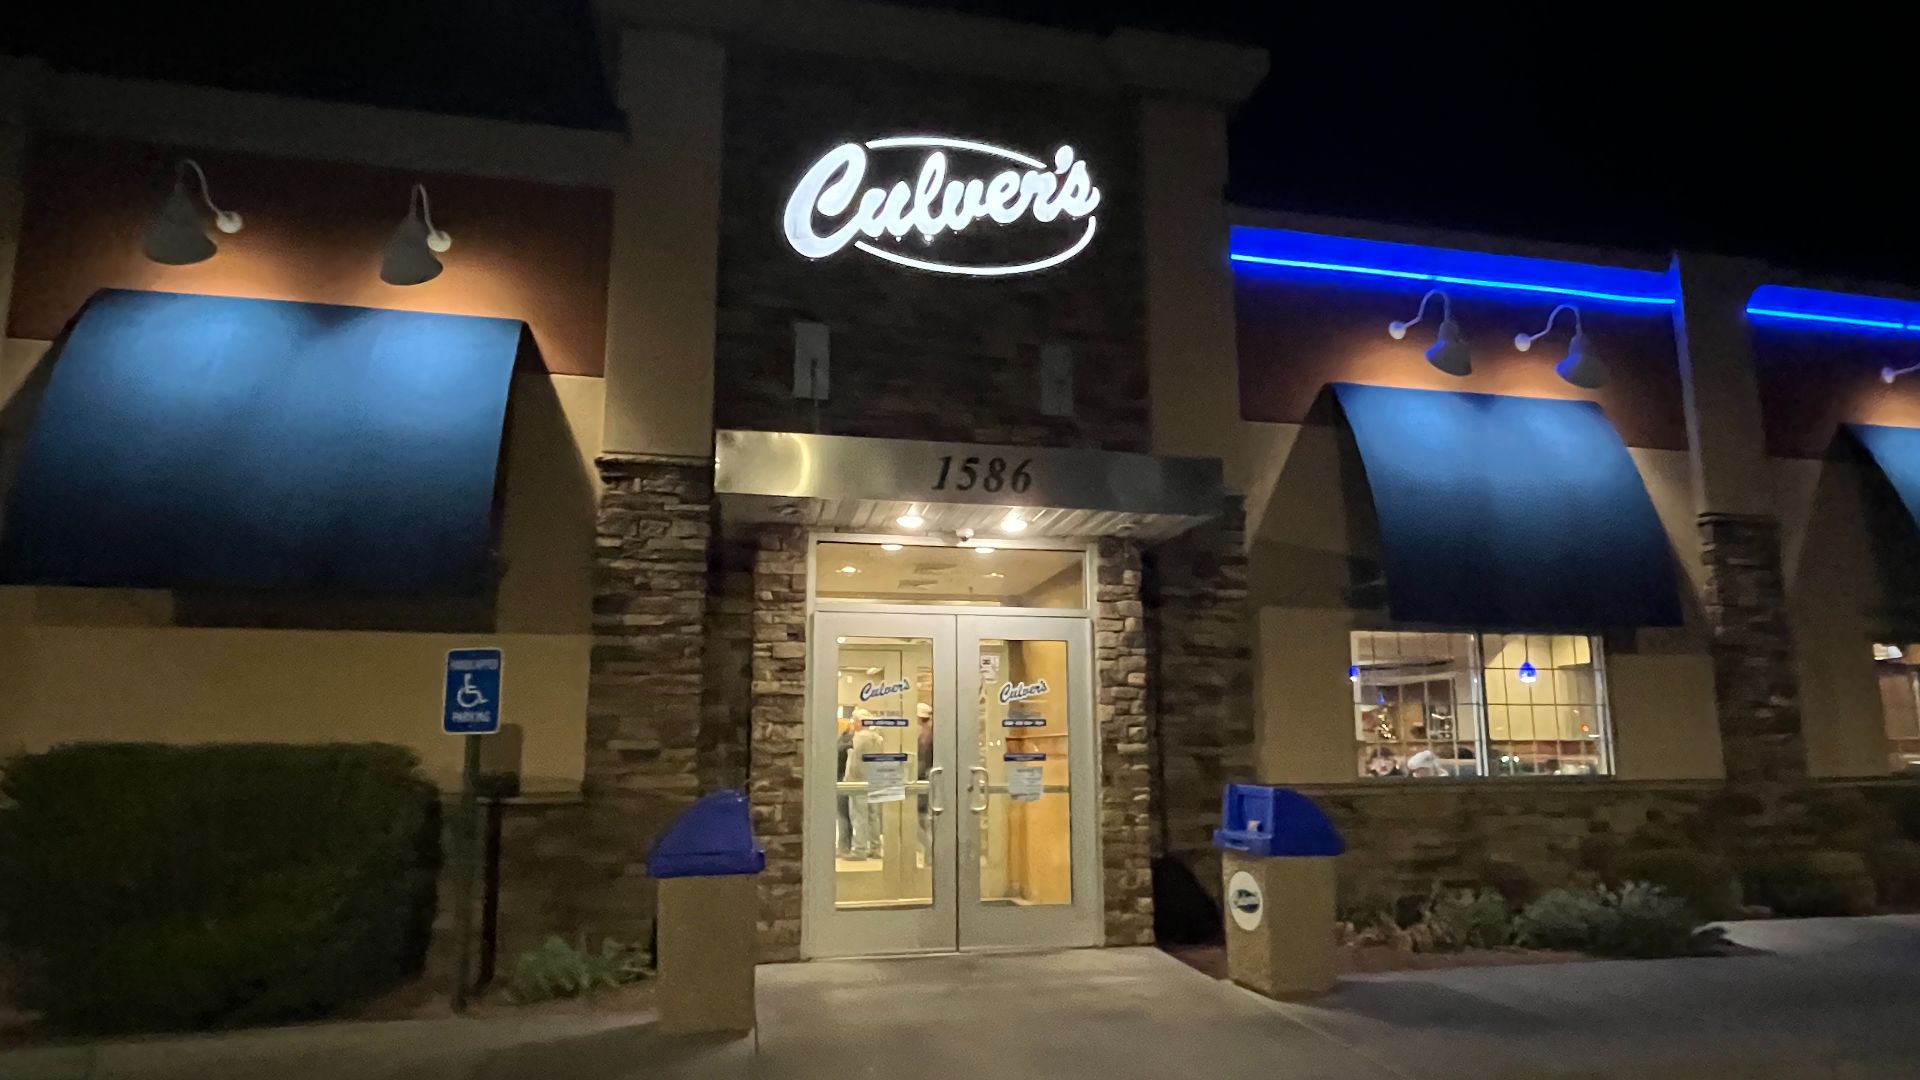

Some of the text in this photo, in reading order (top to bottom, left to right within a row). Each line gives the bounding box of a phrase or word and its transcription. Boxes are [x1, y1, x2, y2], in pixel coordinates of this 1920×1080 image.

[784, 142, 1101, 259] Culver's
[931, 456, 1033, 494] 1586
[860, 679, 910, 702] Culver's
[999, 680, 1048, 704] Culver's
